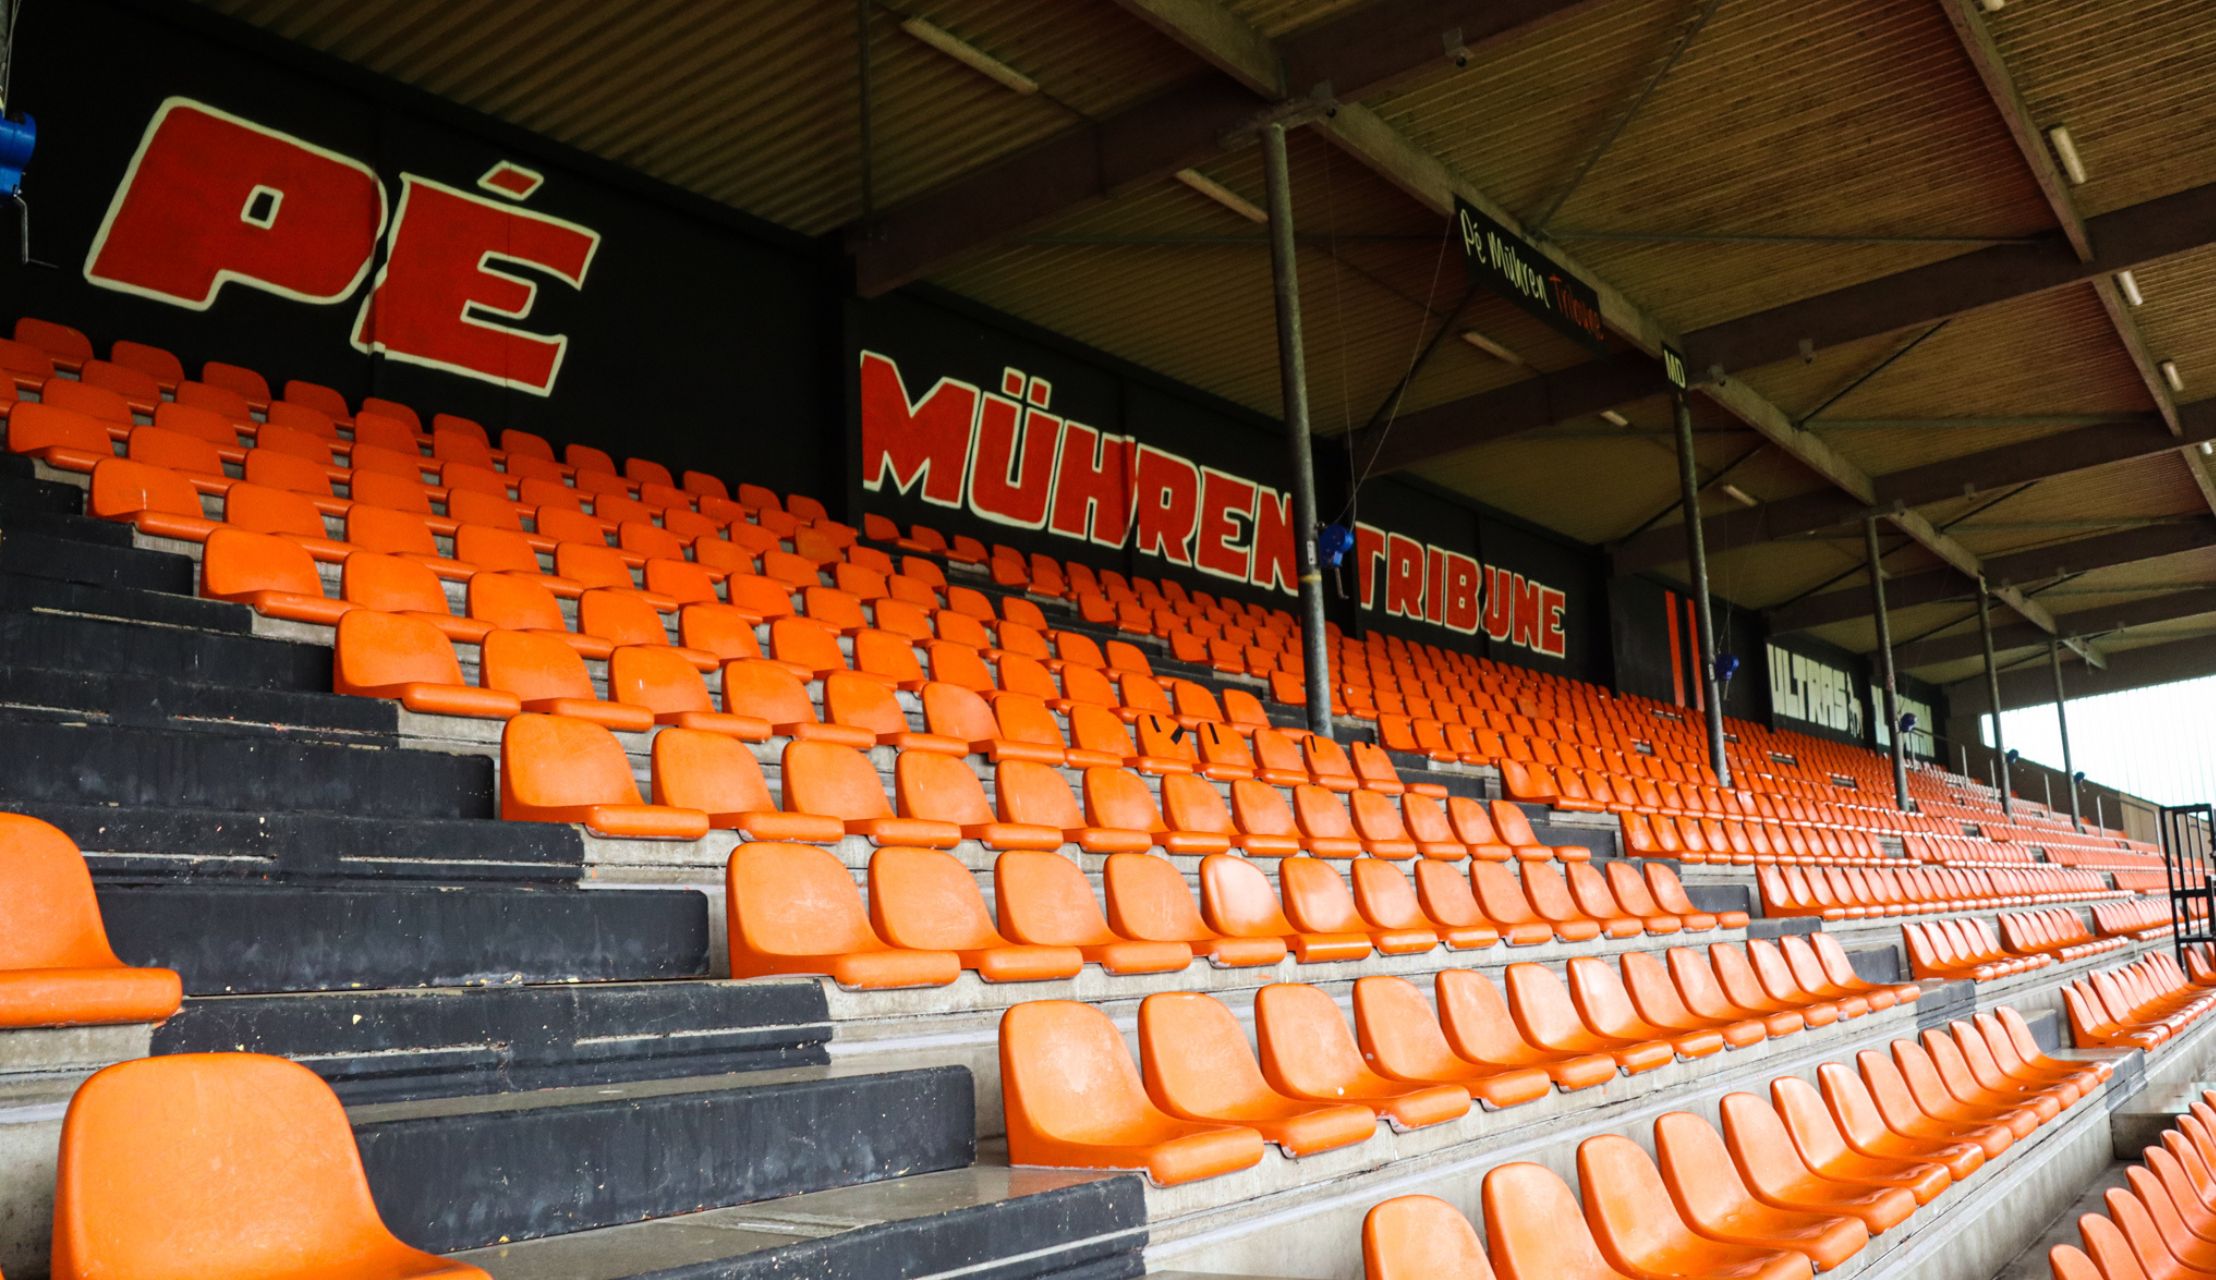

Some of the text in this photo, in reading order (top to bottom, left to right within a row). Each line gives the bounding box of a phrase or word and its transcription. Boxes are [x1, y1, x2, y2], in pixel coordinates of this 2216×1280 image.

[1460, 208, 1487, 264] Pé
[1487, 230, 1551, 309] Mühren
[84, 96, 1566, 659] PÉ MÜHREN TRIBUNE
[1664, 348, 1687, 389] MD
[1766, 641, 1849, 732] ULTRAS
